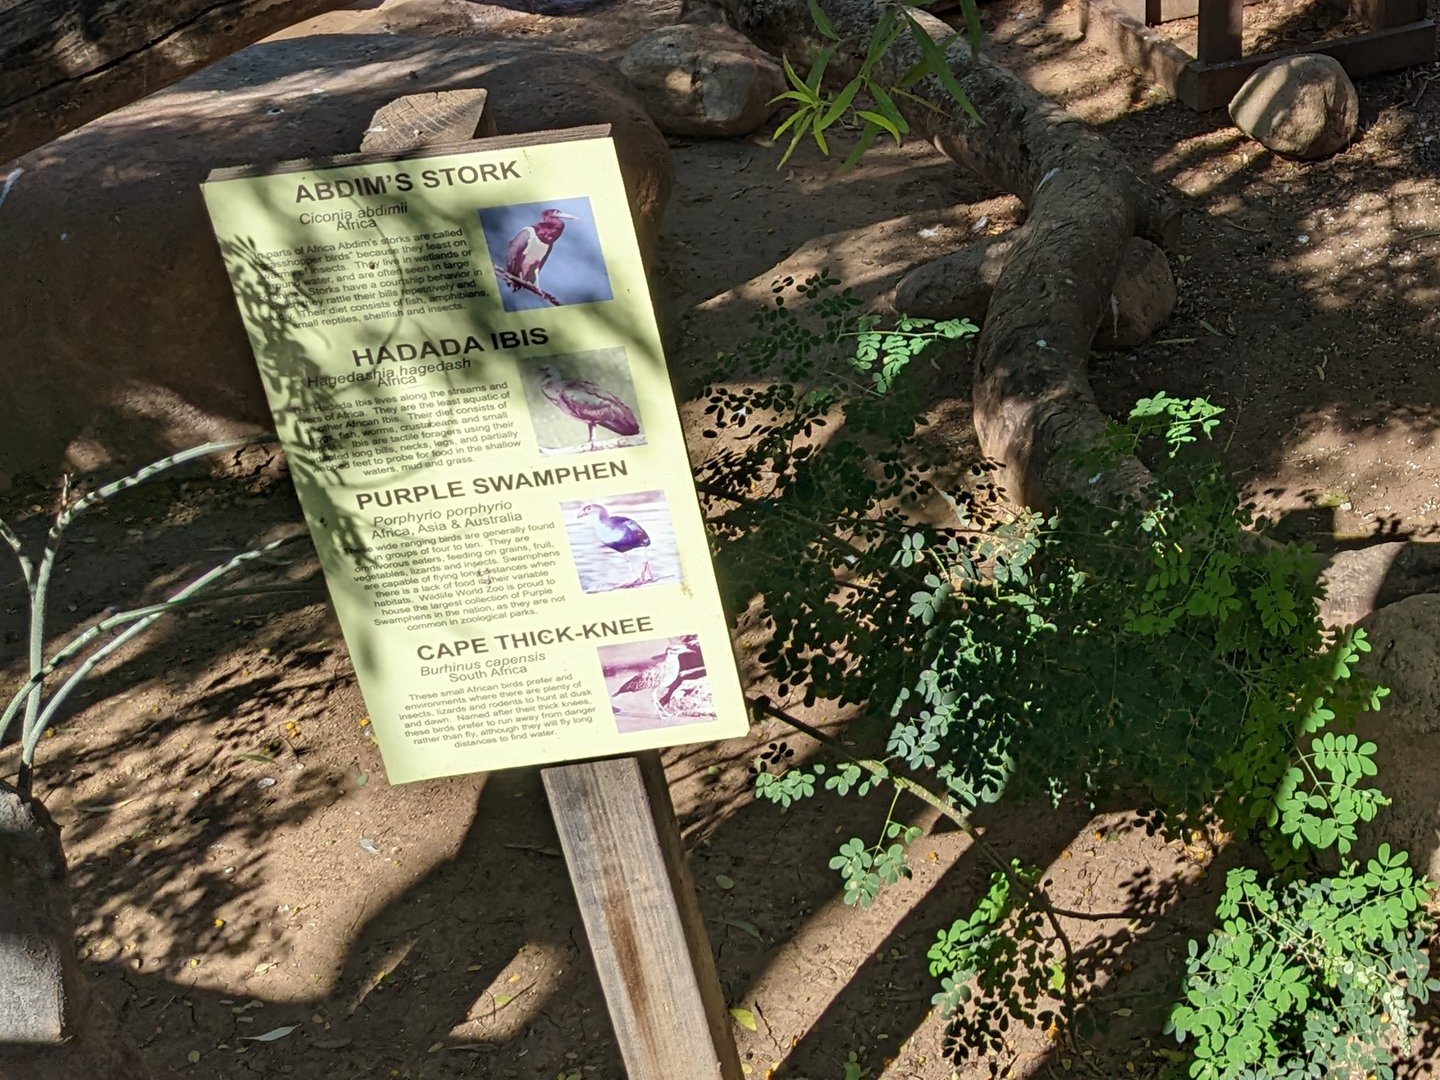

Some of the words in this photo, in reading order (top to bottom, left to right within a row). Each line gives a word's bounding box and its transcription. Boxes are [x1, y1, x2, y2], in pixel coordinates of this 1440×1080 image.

[421, 160, 521, 189] STORK
[298, 209, 353, 226] Ciconia
[357, 202, 409, 219] abdimii
[336, 217, 377, 232] Africa
[362, 308, 405, 321] shellfish
[406, 306, 426, 316] and
[352, 335, 485, 367] HADADA
[491, 327, 550, 351] IBIS
[306, 367, 396, 389] Hagedashia
[399, 358, 471, 379] hagedash
[377, 374, 417, 388] Africa
[401, 461, 423, 472] mud
[425, 459, 444, 469] and
[355, 480, 466, 511] PURPLE
[472, 459, 628, 495] SWAMPHEN
[372, 510, 442, 529] Porphyrio
[446, 501, 513, 520] porphyrio
[418, 523, 448, 534] Asia
[464, 512, 523, 528] Australia
[380, 607, 411, 616] house
[412, 604, 429, 612] the
[429, 599, 463, 610] largest
[464, 594, 509, 606] collection
[521, 587, 553, 598] Purple
[418, 591, 454, 602] Wildlife
[454, 587, 484, 597] World
[486, 585, 505, 593] Zoo
[516, 579, 545, 591] proud
[373, 613, 433, 627] Swamphens
[444, 609, 461, 617] the
[509, 600, 531, 609] they
[532, 598, 549, 606] are
[550, 594, 567, 603] not
[406, 620, 448, 632] common
[460, 611, 508, 625] zoological
[416, 637, 490, 661] CAPE
[493, 615, 654, 651] THICK-KNEE
[420, 661, 482, 677] Burhinus
[485, 652, 546, 669] capensis
[448, 669, 488, 683] South
[490, 665, 528, 677] Africa
[404, 697, 467, 711] environments
[468, 693, 498, 702] where
[499, 690, 523, 698] there
[525, 687, 541, 695] are
[542, 683, 571, 694] plenty
[408, 692, 439, 701] These
[440, 687, 465, 697] small
[466, 684, 499, 694] African
[500, 680, 524, 689] birds
[525, 676, 553, 687] prefer
[555, 673, 573, 683] arid
[404, 719, 423, 729] and
[456, 711, 491, 722] Named
[492, 708, 513, 717] after
[515, 705, 536, 714] their
[537, 701, 560, 711] thick
[436, 706, 467, 715] lizards
[469, 702, 487, 711] and
[488, 698, 523, 708] rodents
[535, 693, 557, 702] hunt
[570, 688, 593, 698] dusk
[453, 737, 498, 749] distances
[510, 732, 528, 741] find
